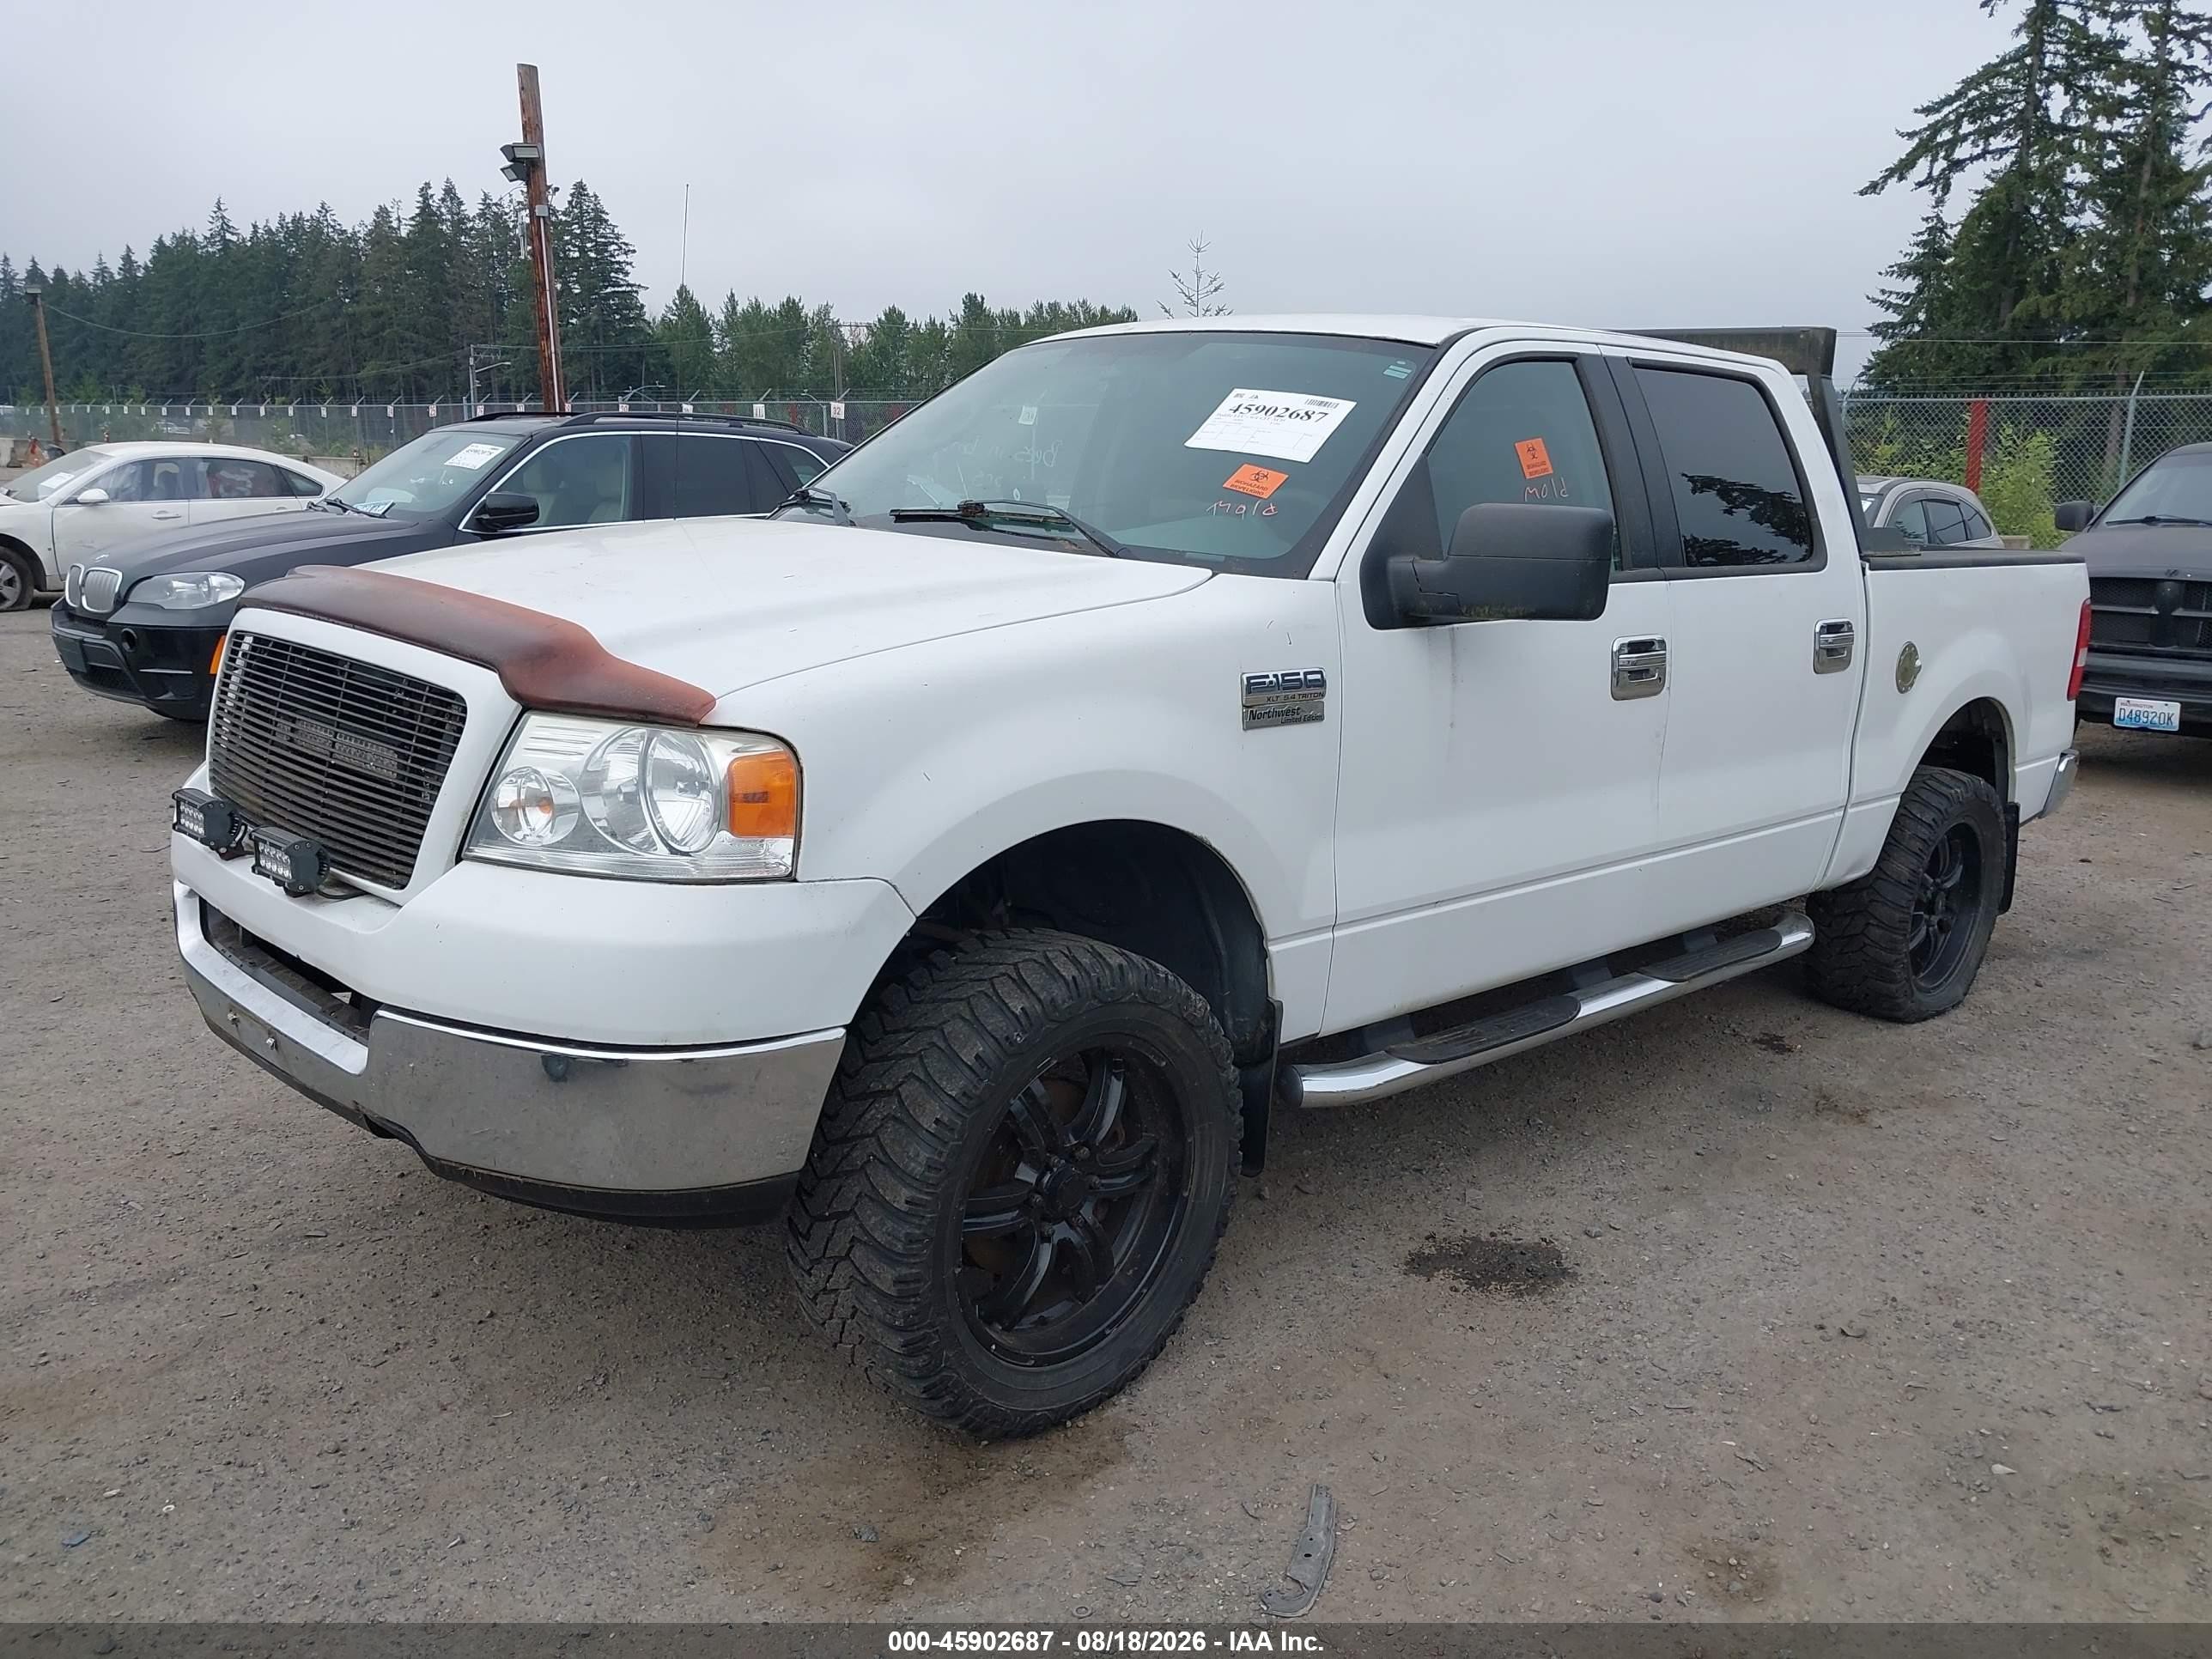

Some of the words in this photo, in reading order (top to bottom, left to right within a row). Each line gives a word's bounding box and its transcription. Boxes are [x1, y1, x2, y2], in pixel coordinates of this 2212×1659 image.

[1230, 403, 1328, 422] 45902687
[1234, 480, 1268, 492] BIOHAZARD
[1248, 707, 1301, 721] Northwest
[1280, 715, 1302, 724] Limited
[1303, 714, 1323, 722] Edition
